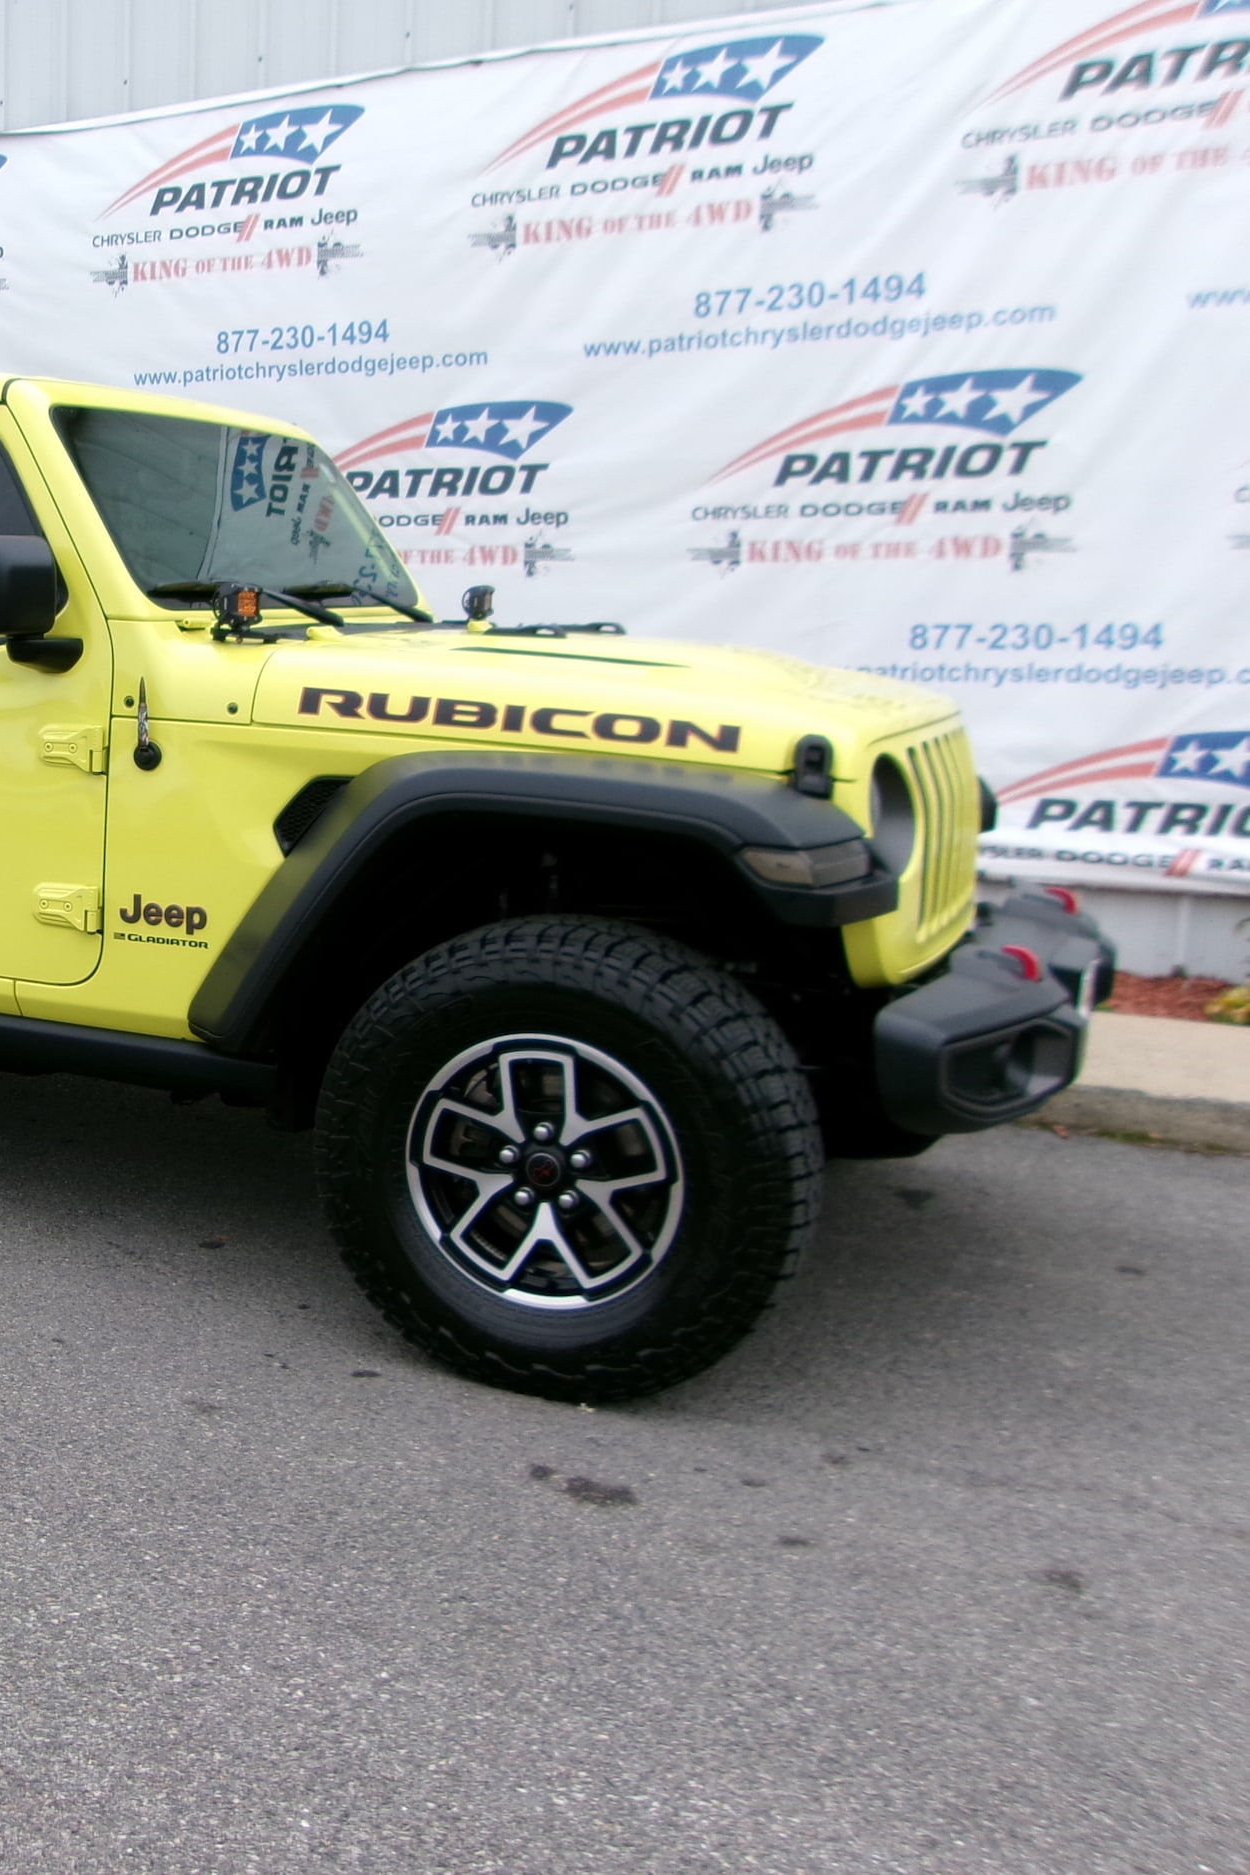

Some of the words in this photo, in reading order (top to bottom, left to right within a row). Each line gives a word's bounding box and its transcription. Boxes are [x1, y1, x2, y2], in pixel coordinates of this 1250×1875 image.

[1059, 38, 1250, 101] PATR
[546, 101, 794, 170] PATRIOT
[962, 119, 1078, 149] CHRYSLER
[1091, 100, 1218, 132] DODGE
[150, 164, 342, 217] PATRIOT
[471, 184, 561, 208] CHRYSLER
[570, 173, 664, 197] DODGE
[690, 164, 743, 183] RAM
[753, 153, 815, 175] Jeep
[1026, 157, 1118, 191] KING
[92, 230, 162, 248] CHRYSLER
[169, 221, 244, 240] DODGE
[263, 216, 303, 231] RAM
[311, 208, 358, 226] Jeep
[523, 214, 592, 245] KING
[603, 218, 631, 236] OF
[635, 210, 677, 231] THE
[690, 199, 753, 226] 4WD
[132, 258, 188, 282] KING
[195, 260, 216, 275] OF
[220, 255, 254, 273] THE
[261, 246, 312, 270] 4WD
[693, 272, 926, 319] 877-230-1494
[216, 319, 390, 354] 877-230-1494
[584, 303, 1056, 358] www.patriotchryslerdodgejeep.com
[134, 348, 488, 387] www.patriotchryslerdodgejeep.com
[346, 463, 550, 499] PATRIOT
[772, 440, 1048, 488] PATRIOT
[374, 513, 443, 528] ODGE
[464, 513, 508, 526] RAM
[516, 507, 568, 528] Jeep
[691, 504, 789, 522] CHRYSLER
[799, 502, 903, 518] DODGE
[933, 498, 991, 513] RAM
[1002, 491, 1072, 514] Jeep
[418, 549, 454, 565] THE
[463, 545, 517, 567] 4WD
[747, 540, 824, 564] KING
[834, 543, 861, 559] OF
[870, 541, 917, 558] THE
[908, 622, 1164, 651] 877-230-1494
[298, 687, 741, 753] RUBICON
[1056, 850, 1174, 868] DODGE
[1209, 857, 1250, 871] RA
[120, 894, 207, 935] Jeep
[127, 933, 209, 949] GLADIATOR
